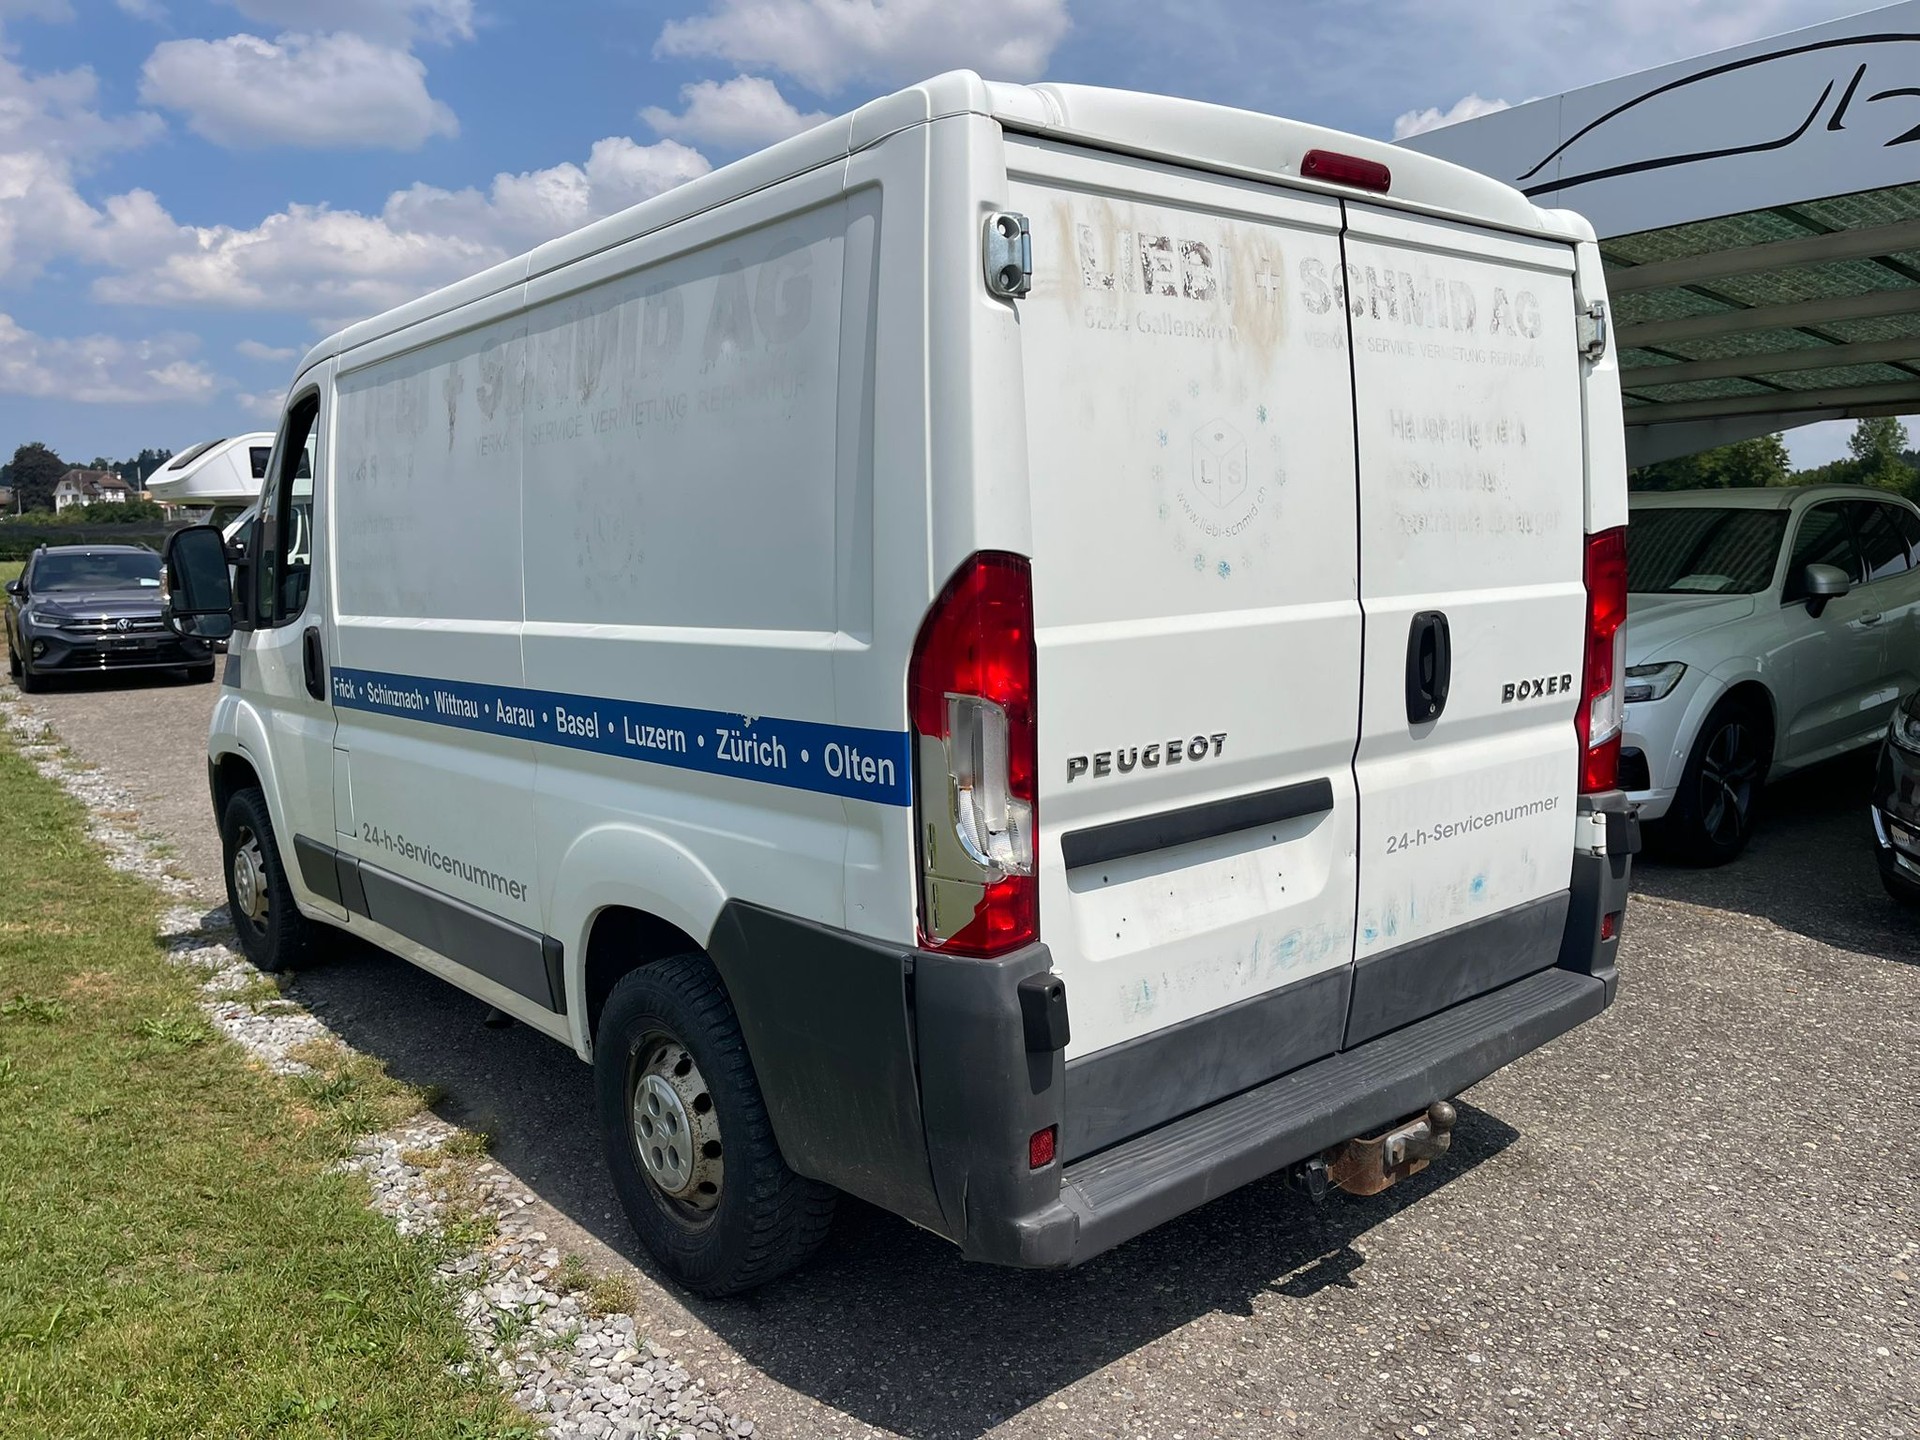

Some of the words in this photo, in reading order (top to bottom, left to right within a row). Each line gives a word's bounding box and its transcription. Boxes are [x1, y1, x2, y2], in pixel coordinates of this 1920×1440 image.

[1489, 286, 1545, 340] AG
[1501, 674, 1572, 703] BOXER
[333, 676, 356, 699] Frick
[366, 682, 424, 711] Schinznach
[433, 690, 479, 719] Wittnau
[496, 698, 535, 728] Aarau
[555, 706, 600, 739] Basel
[623, 716, 686, 753] Luzern
[715, 728, 787, 769] Zürich
[823, 742, 895, 786] Olten
[1067, 732, 1228, 784] PEUGEOT
[1386, 796, 1559, 854] 24-h-Servicenummer
[362, 822, 527, 902] 24-h-Servicenummer
